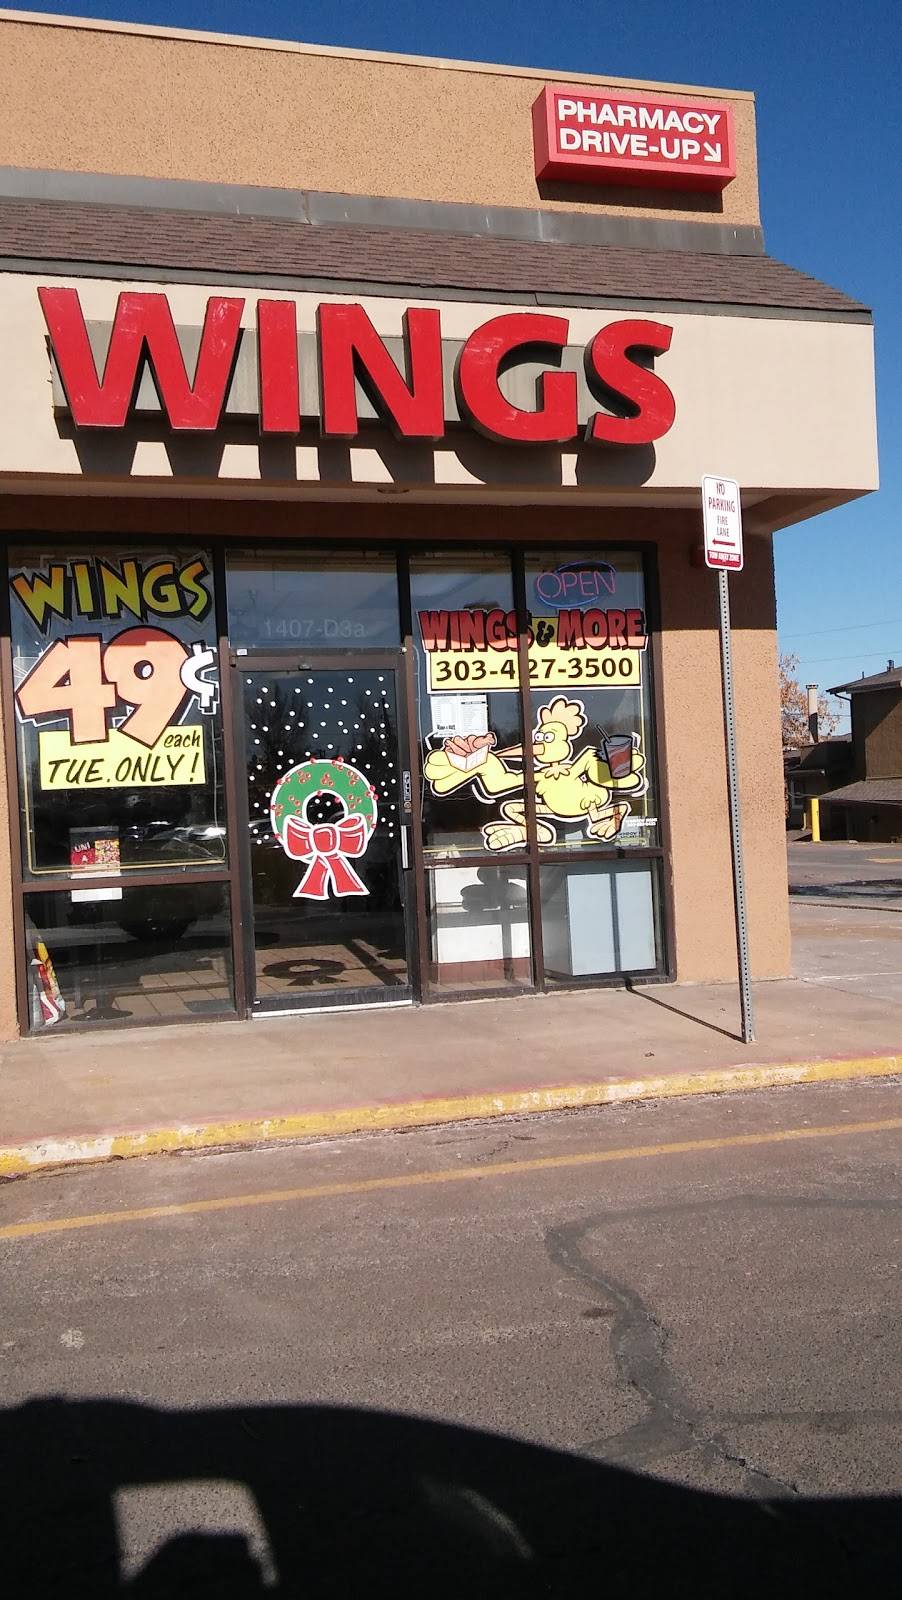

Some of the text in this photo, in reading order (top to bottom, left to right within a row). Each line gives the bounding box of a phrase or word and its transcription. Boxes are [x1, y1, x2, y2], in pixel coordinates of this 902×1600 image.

[557, 99, 721, 135] PHARMACY
[559, 127, 701, 161] DRIVE-UP
[37, 286, 675, 445] WINGS
[716, 482, 725, 495] NO
[708, 496, 735, 513] PARKING
[716, 527, 729, 537] LANE
[717, 515, 728, 526] FIRE
[11, 558, 210, 635] WINGS
[536, 569, 616, 599] OPEN
[417, 608, 648, 653] WINGS & MORE
[435, 656, 633, 682] 303-427-3500
[163, 729, 201, 749] each
